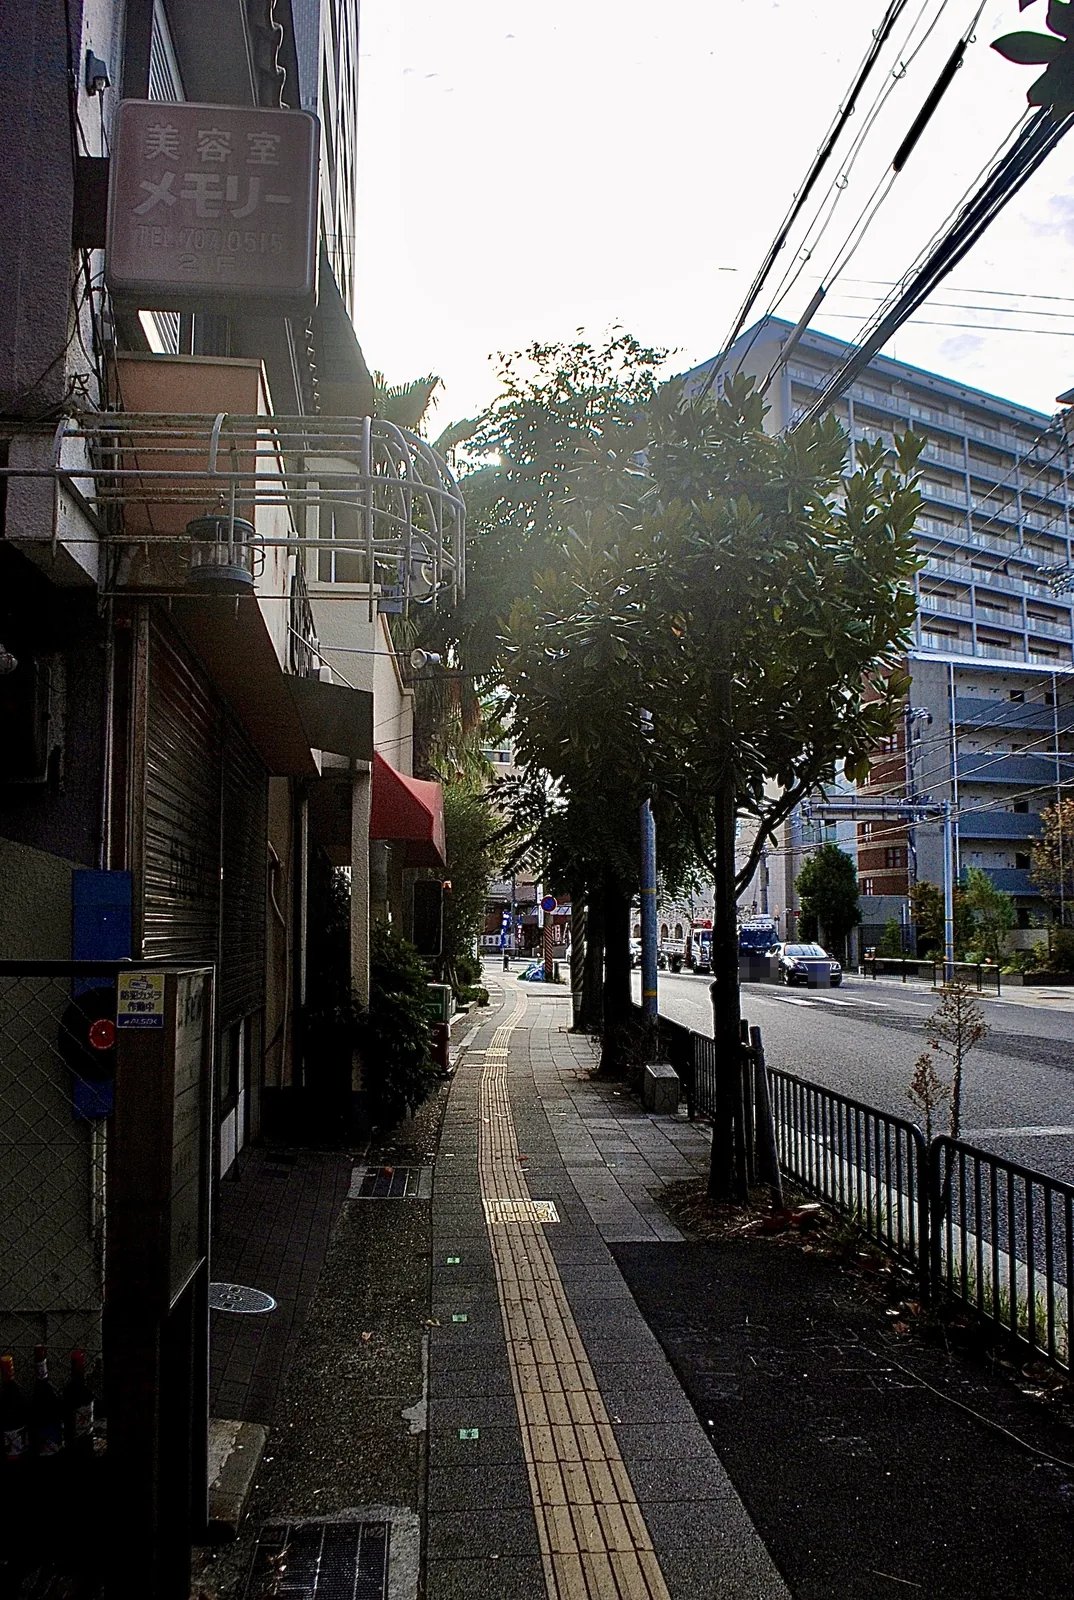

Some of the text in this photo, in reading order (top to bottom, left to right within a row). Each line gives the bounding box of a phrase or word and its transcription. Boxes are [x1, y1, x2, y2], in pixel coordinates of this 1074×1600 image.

[145, 123, 282, 167] 美容室
[134, 171, 292, 219] メモリー
